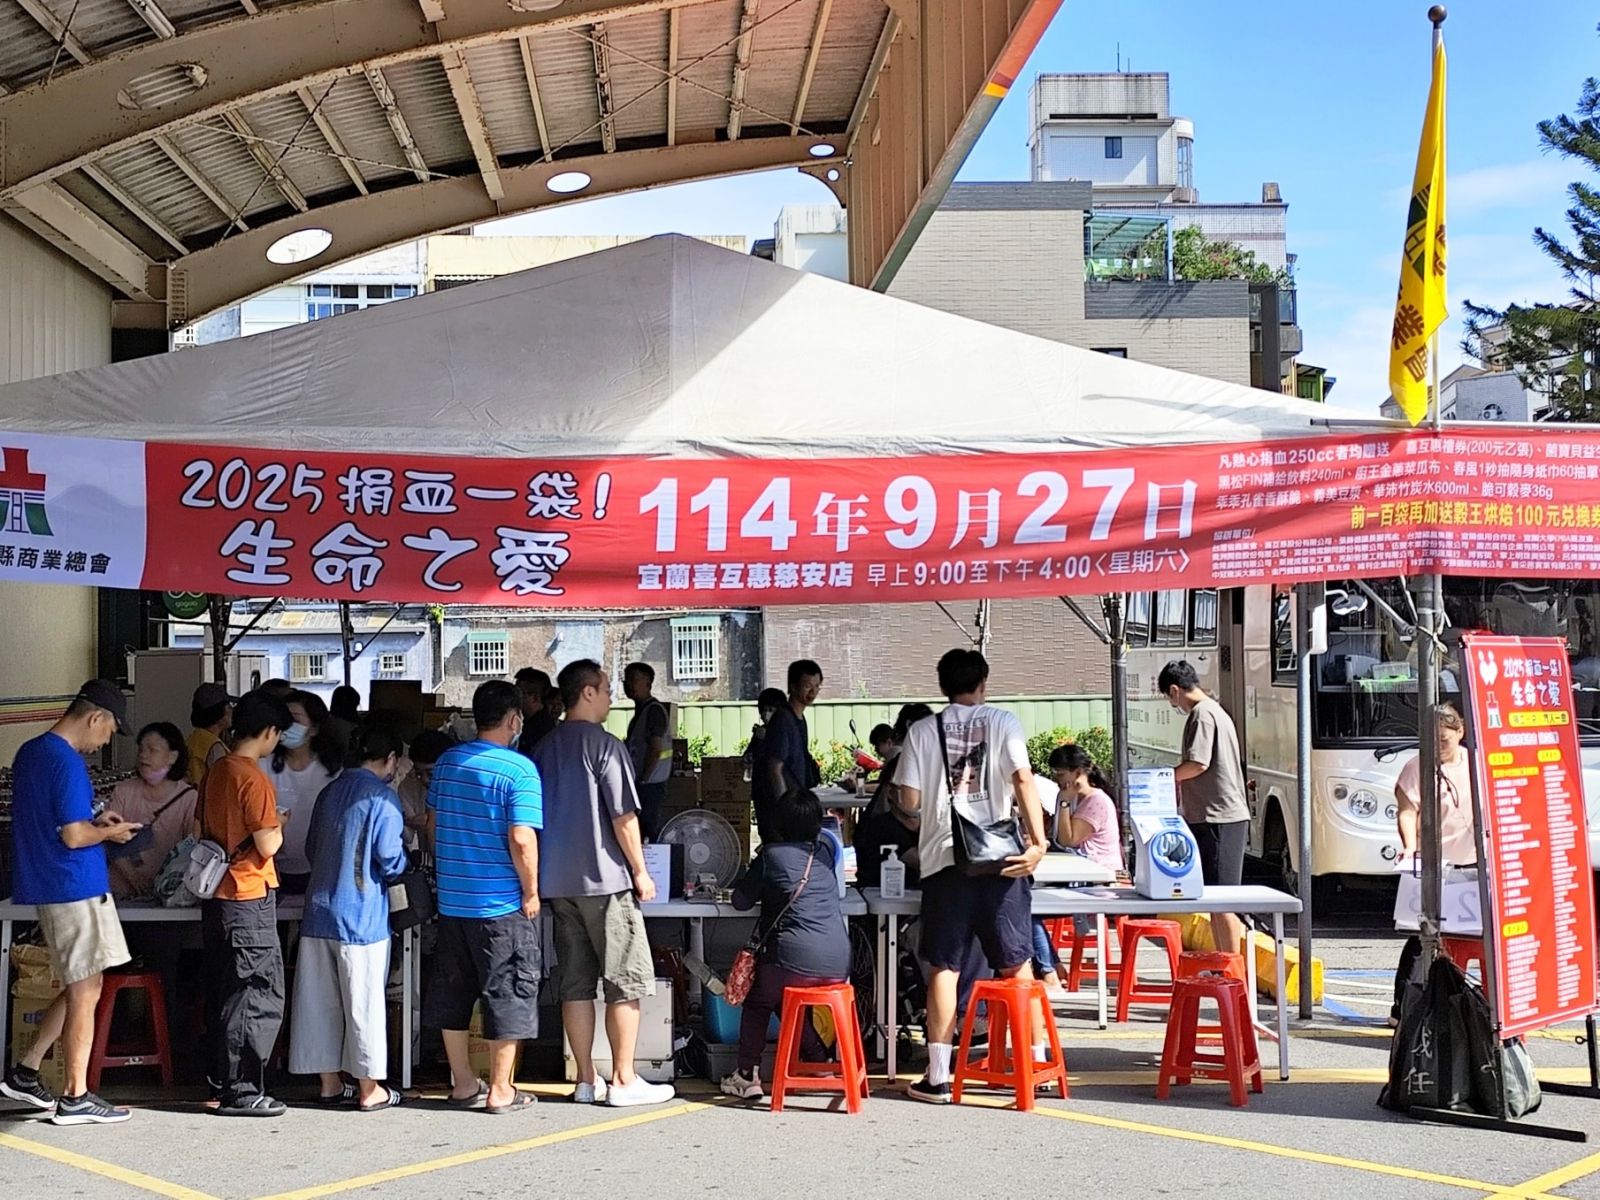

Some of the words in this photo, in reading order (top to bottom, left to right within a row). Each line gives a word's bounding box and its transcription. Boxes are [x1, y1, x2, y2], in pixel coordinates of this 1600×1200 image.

[637, 466, 1199, 553] 114年9月27日
[0, 544, 111, 574] 縣商業總會
[219, 519, 571, 596] 生命之愛
[637, 561, 854, 591] 宜蘭喜互惠慈安店
[1511, 680, 1562, 706] 生命之愛
[945, 719, 985, 731] DICKES
